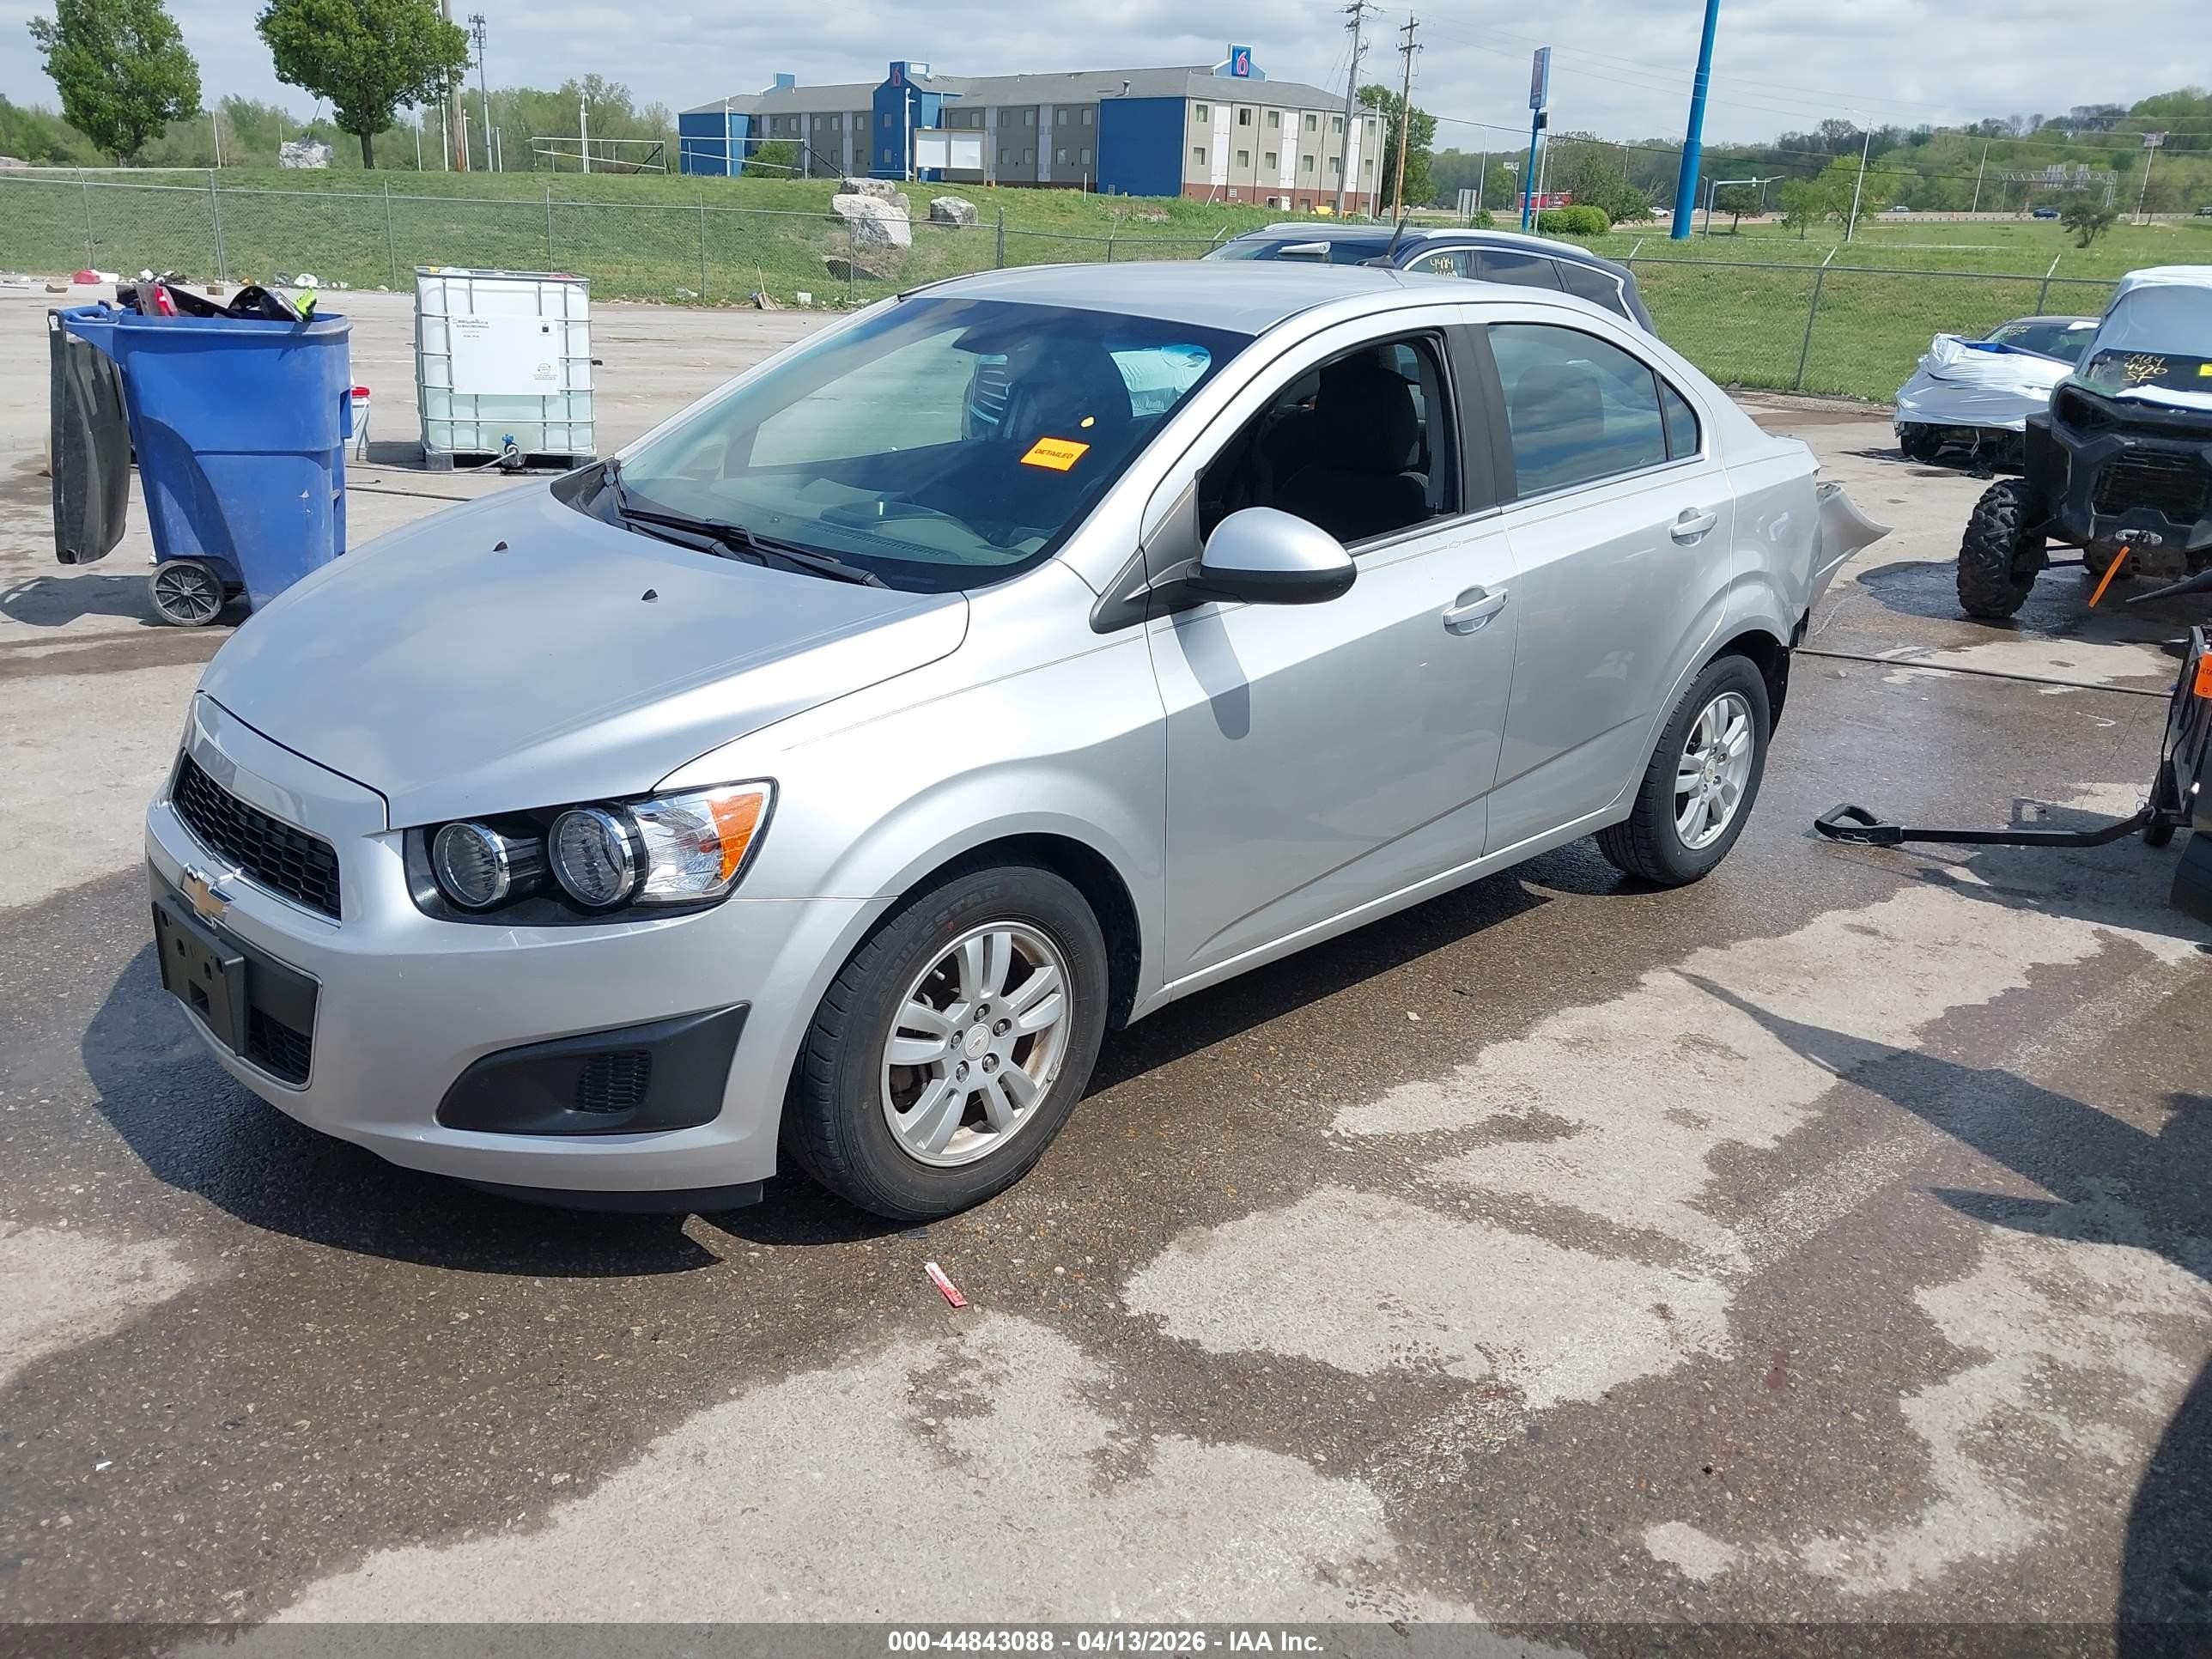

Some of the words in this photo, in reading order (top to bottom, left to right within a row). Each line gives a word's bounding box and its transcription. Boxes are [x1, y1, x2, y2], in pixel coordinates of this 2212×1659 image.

[1237, 51, 1249, 76] 6
[1034, 448, 1074, 459] DETAILED
[886, 884, 1000, 981] MILESTAR
